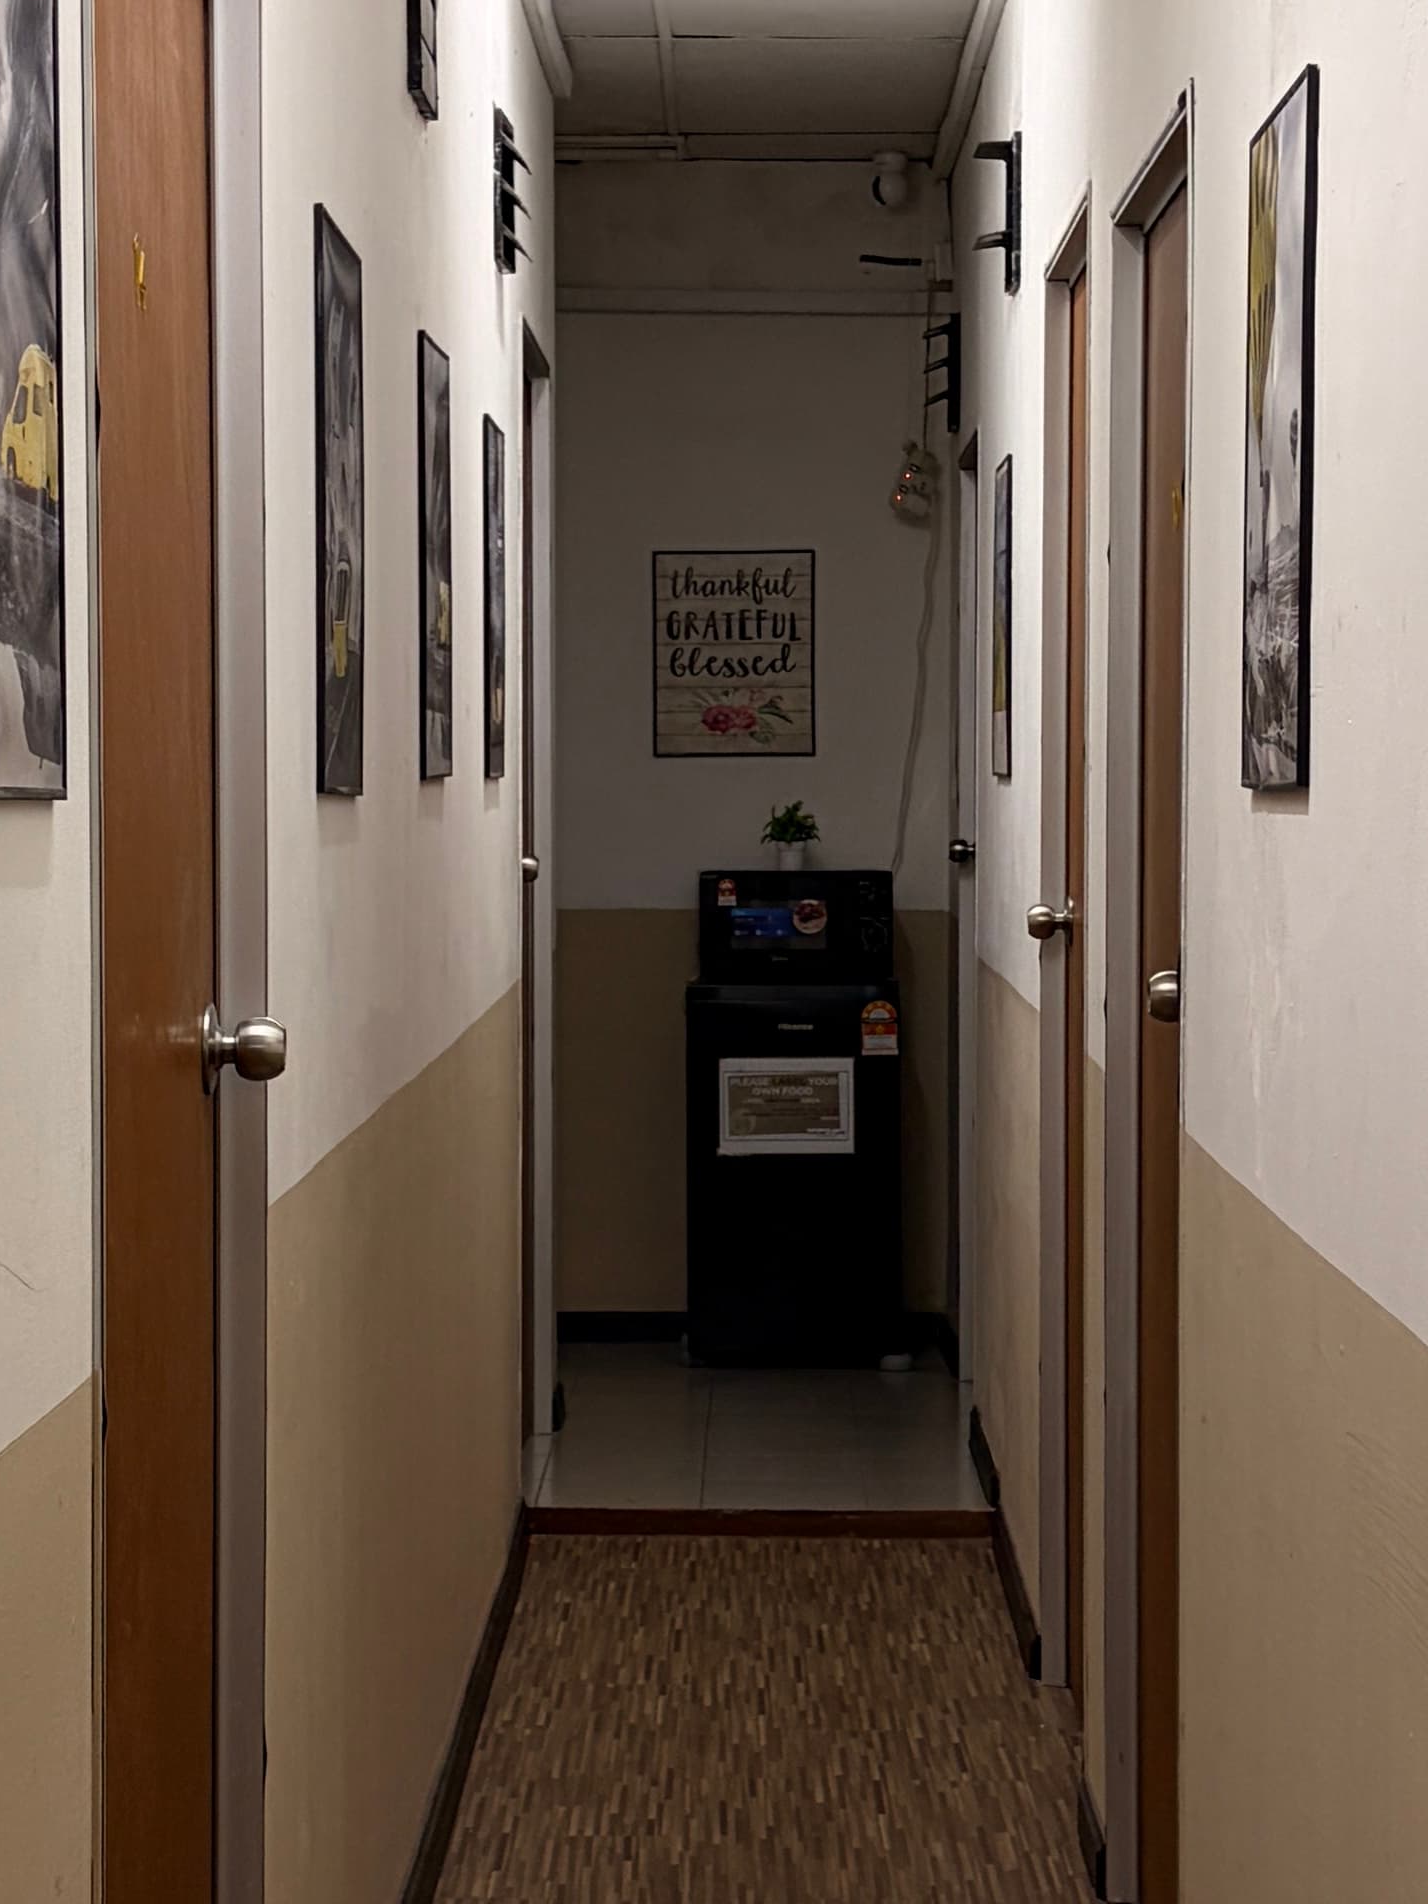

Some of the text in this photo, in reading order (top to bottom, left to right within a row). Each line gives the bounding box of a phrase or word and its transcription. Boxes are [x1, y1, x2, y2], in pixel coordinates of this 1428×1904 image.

[669, 566, 796, 605] thankful
[666, 608, 802, 642] GRATEFUL
[669, 643, 796, 678] blessed
